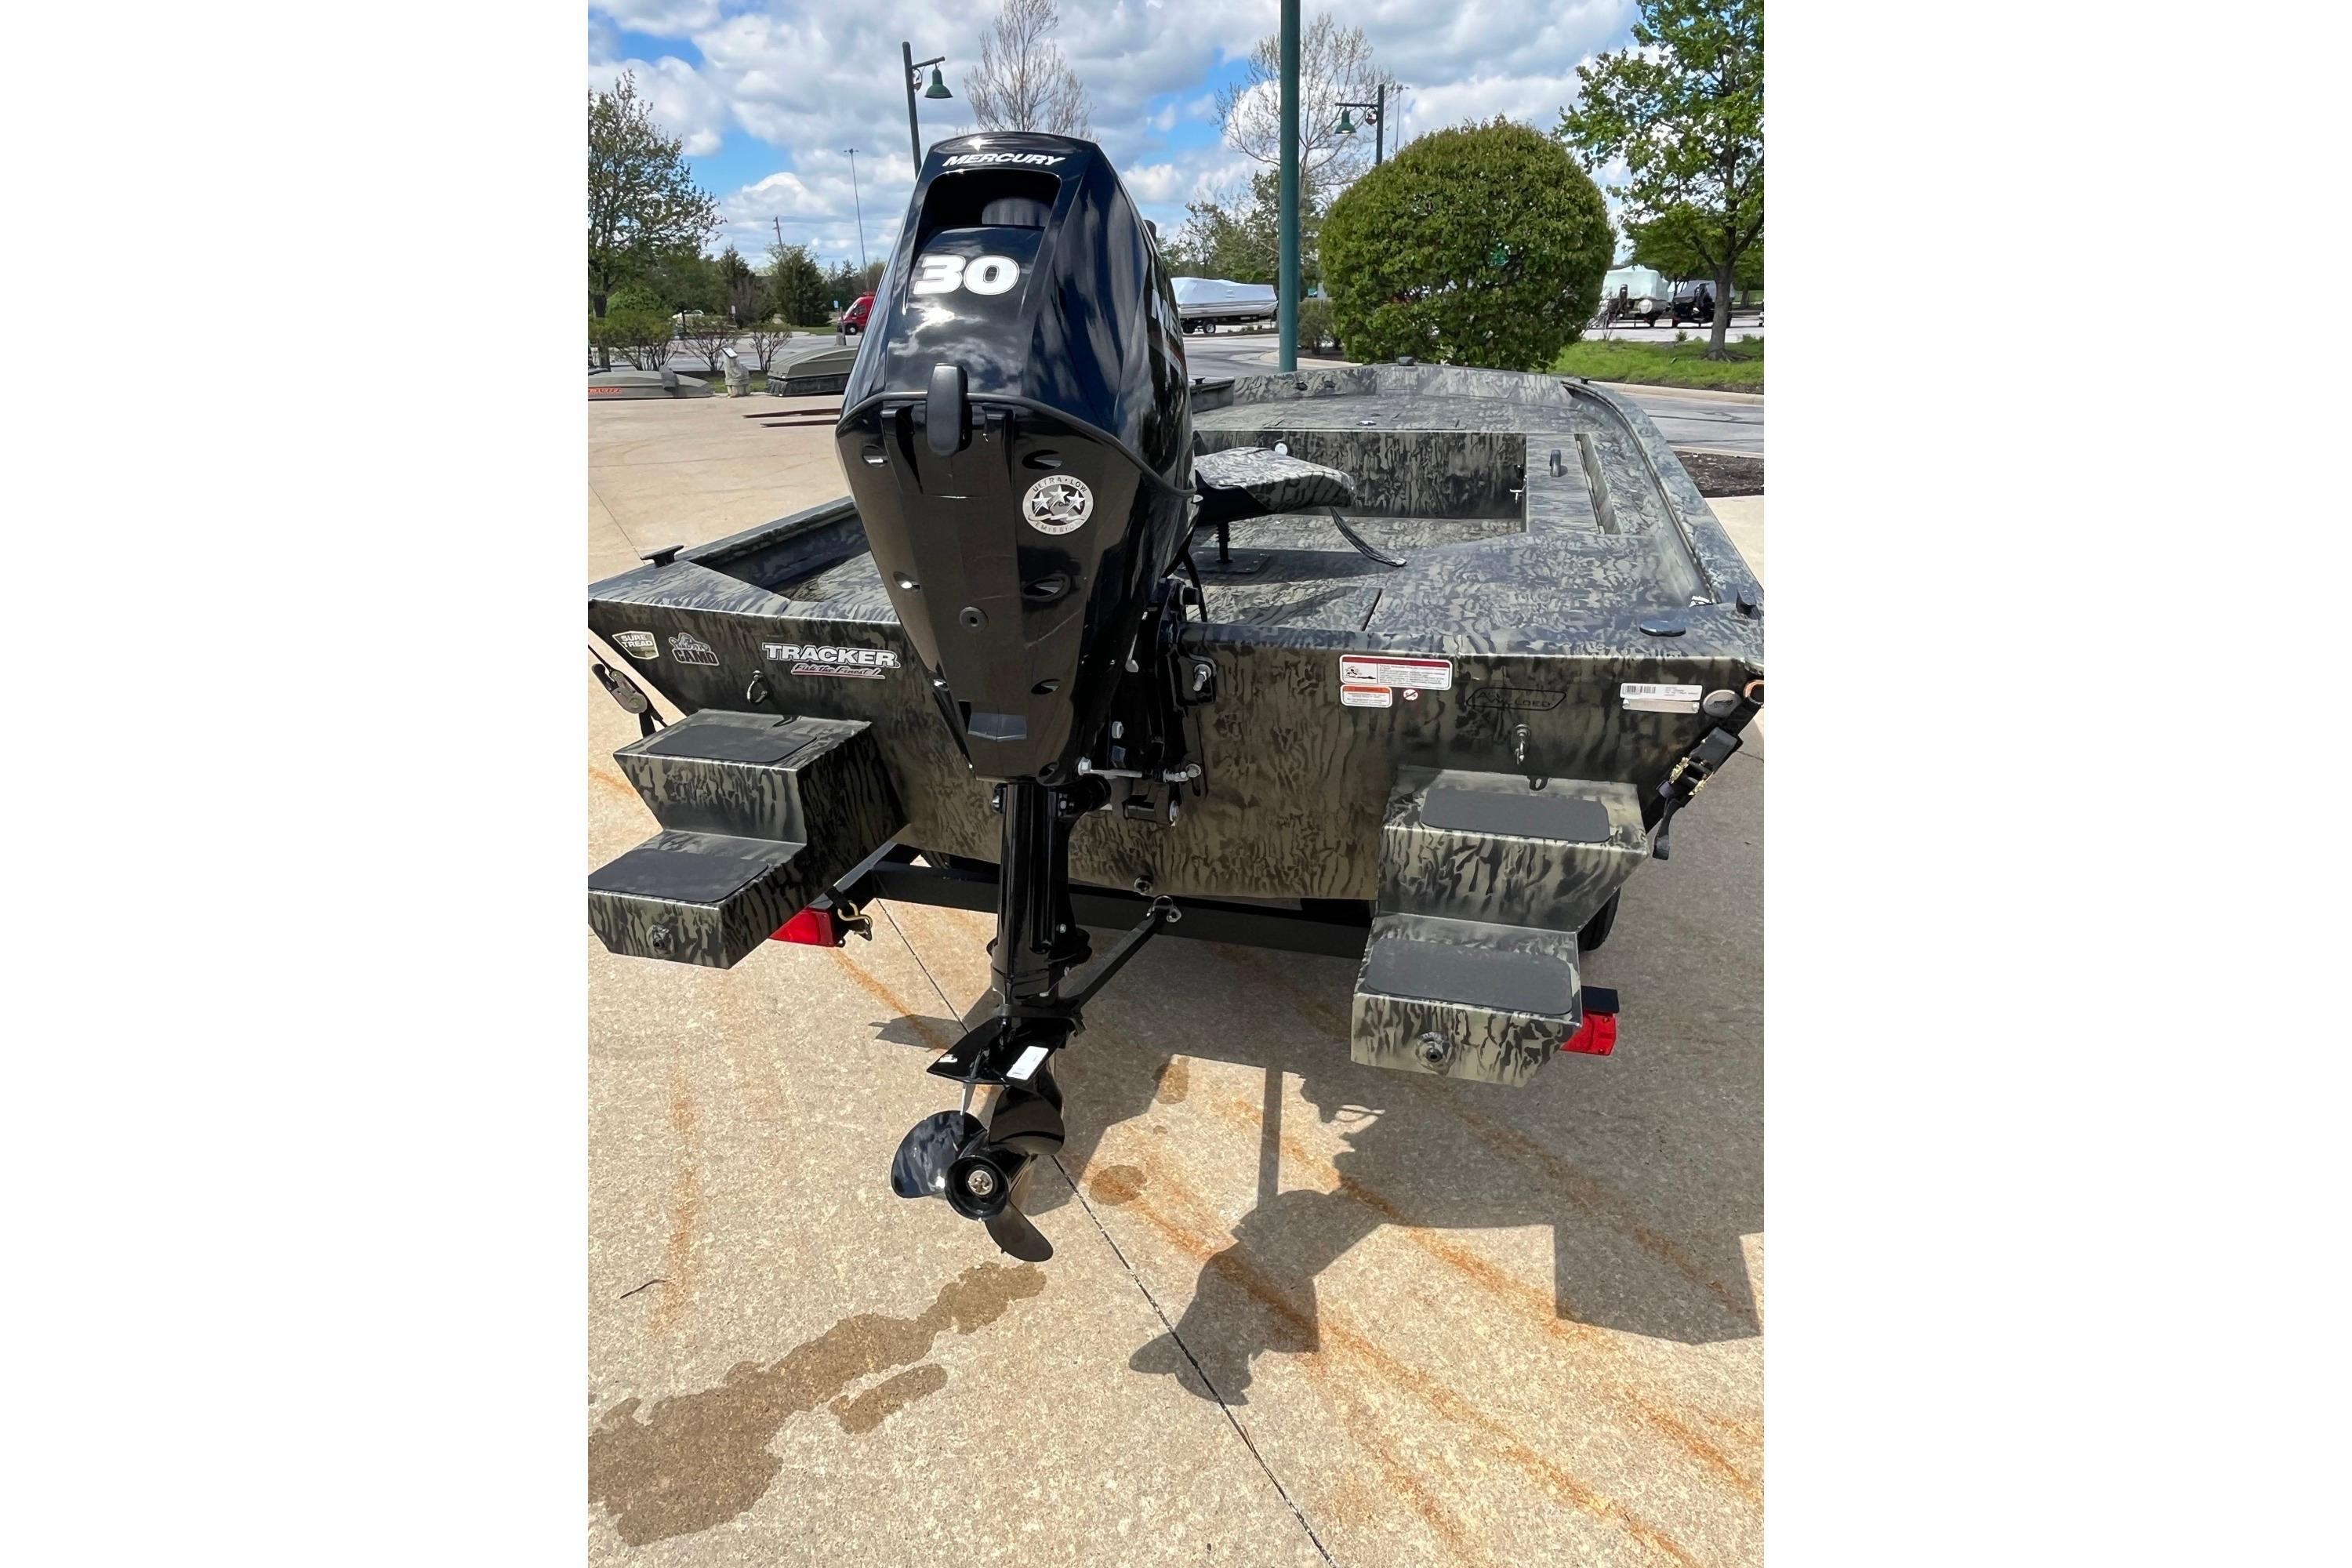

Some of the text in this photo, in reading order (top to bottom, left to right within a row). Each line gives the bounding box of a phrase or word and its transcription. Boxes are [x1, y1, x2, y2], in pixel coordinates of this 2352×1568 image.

[942, 153, 1065, 166] MERCURY
[913, 255, 1020, 295] 30
[1033, 477, 1087, 492] ULTRA LOW
[673, 649, 717, 664] CAMO
[764, 644, 896, 666] TRACKER
